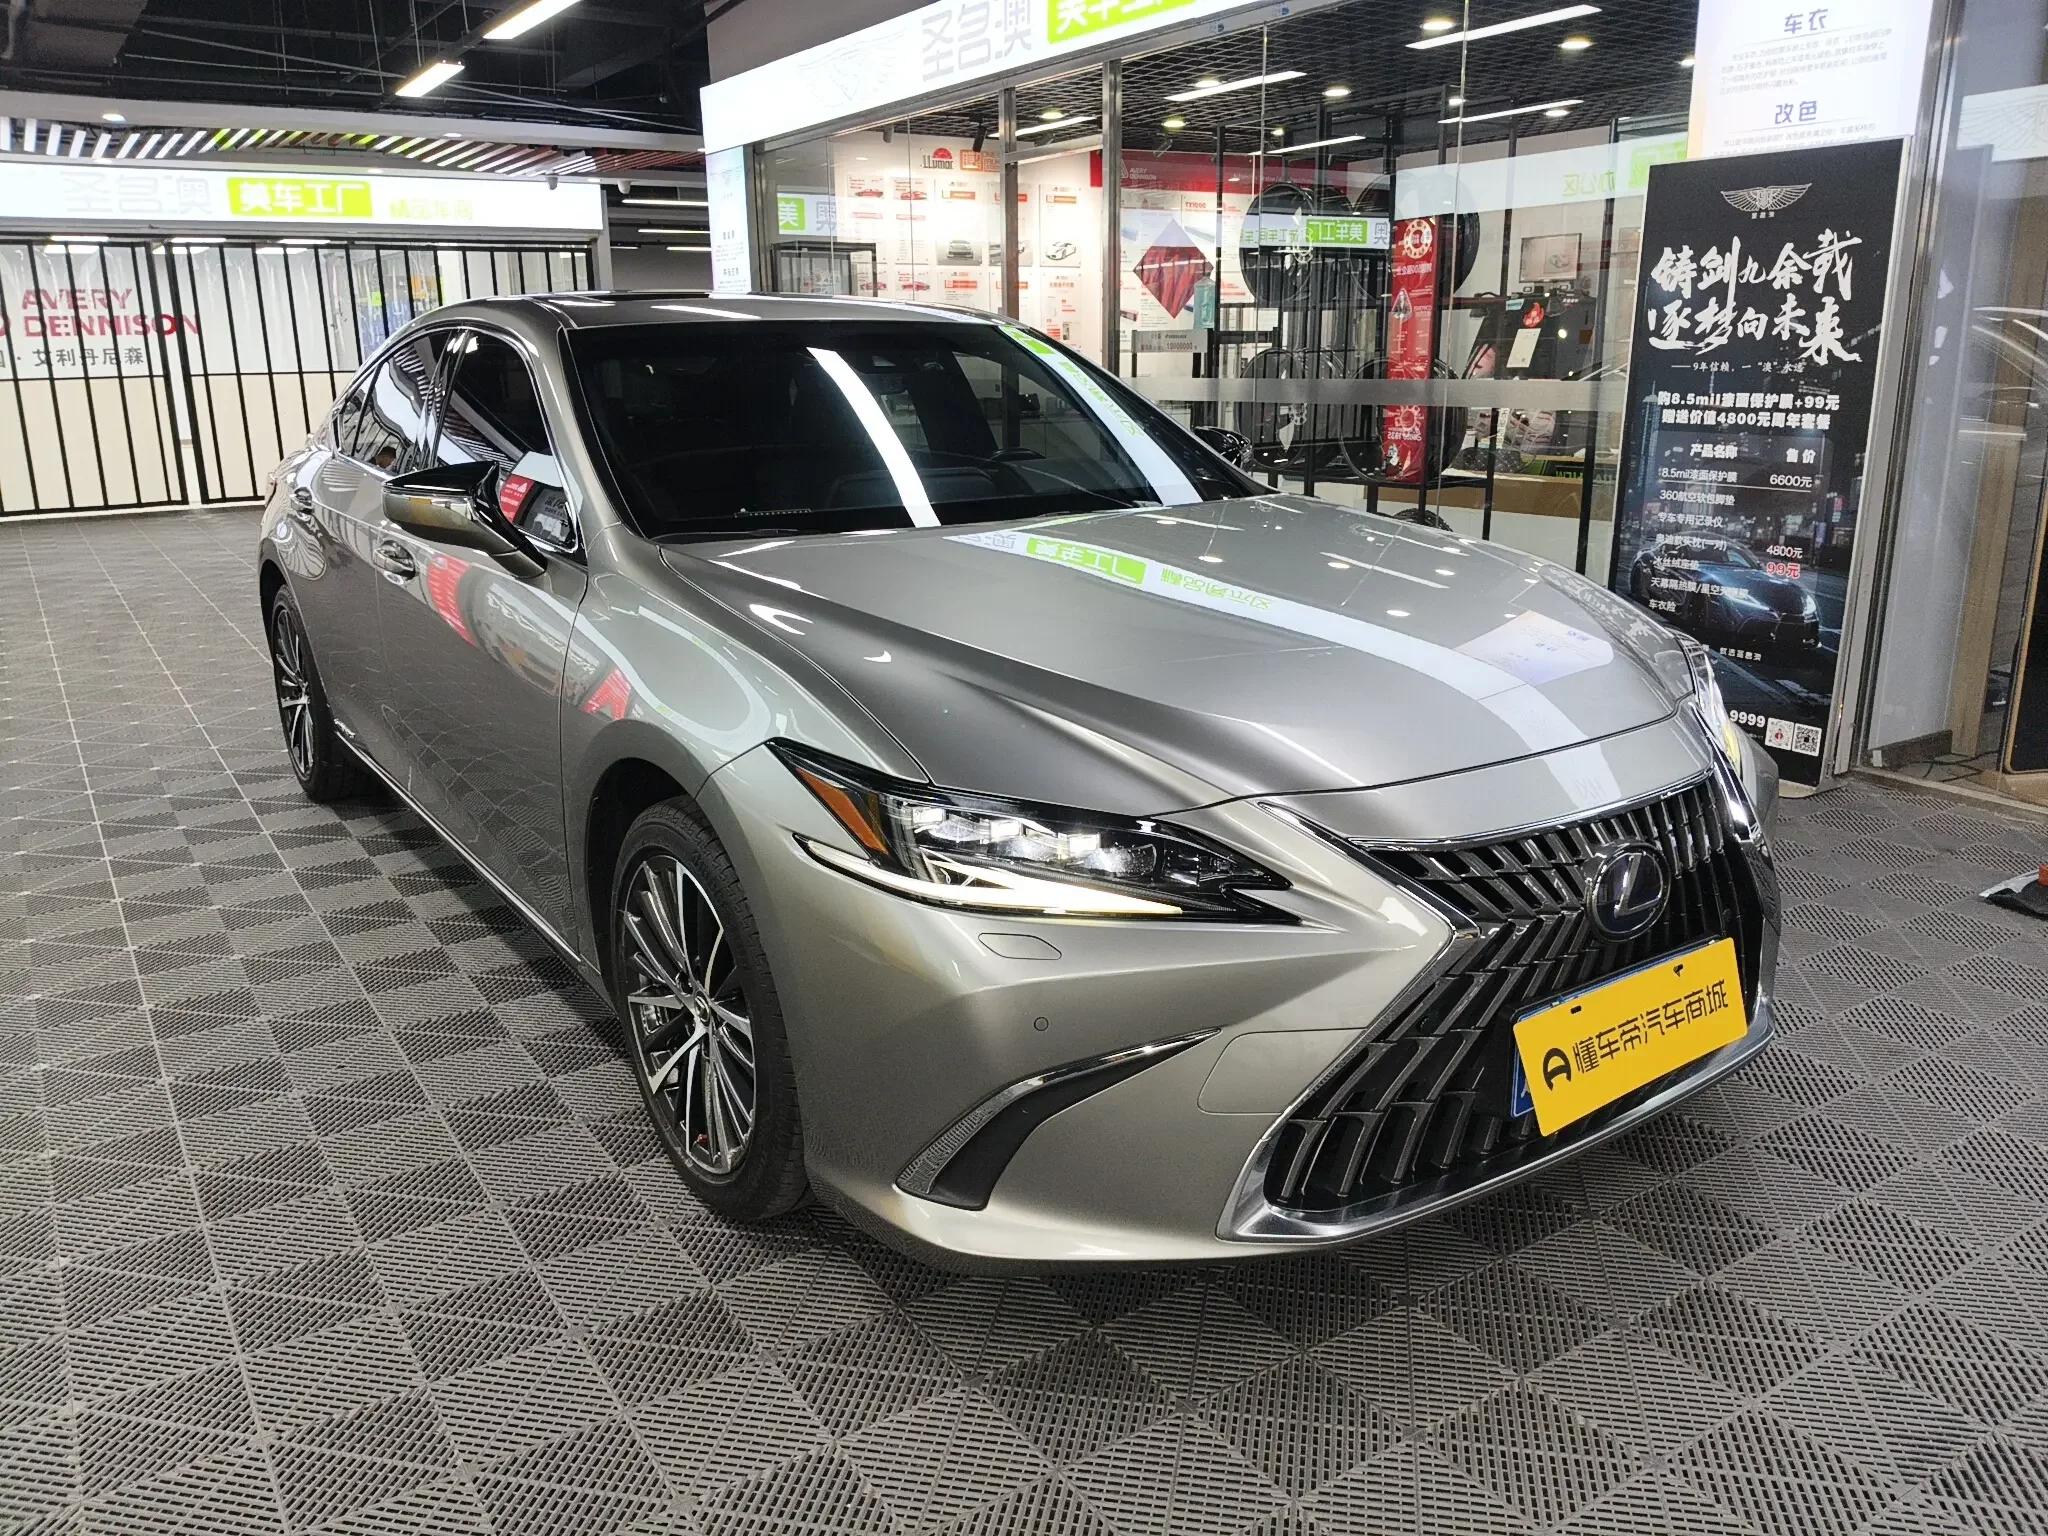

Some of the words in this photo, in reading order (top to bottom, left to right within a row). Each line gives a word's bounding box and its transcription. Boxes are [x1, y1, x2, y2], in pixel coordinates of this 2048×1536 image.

[1783, 8, 1829, 34] 车衣
[1774, 100, 1818, 124] 改色
[240, 180, 366, 213] 美车工厂
[1651, 228, 1863, 306] 铸剑九余载
[22, 288, 133, 310] AVERY
[1648, 293, 1864, 366] 逐梦向未来
[1661, 408, 1832, 431] 赠送价值4800元周年套餐
[1689, 442, 1739, 460] 产品名称
[1769, 473, 1814, 489] 6600元
[1766, 544, 1804, 560] 4800元
[1766, 561, 1801, 579] 99元
[1572, 979, 1730, 1075] 懂车帝汽车商城
